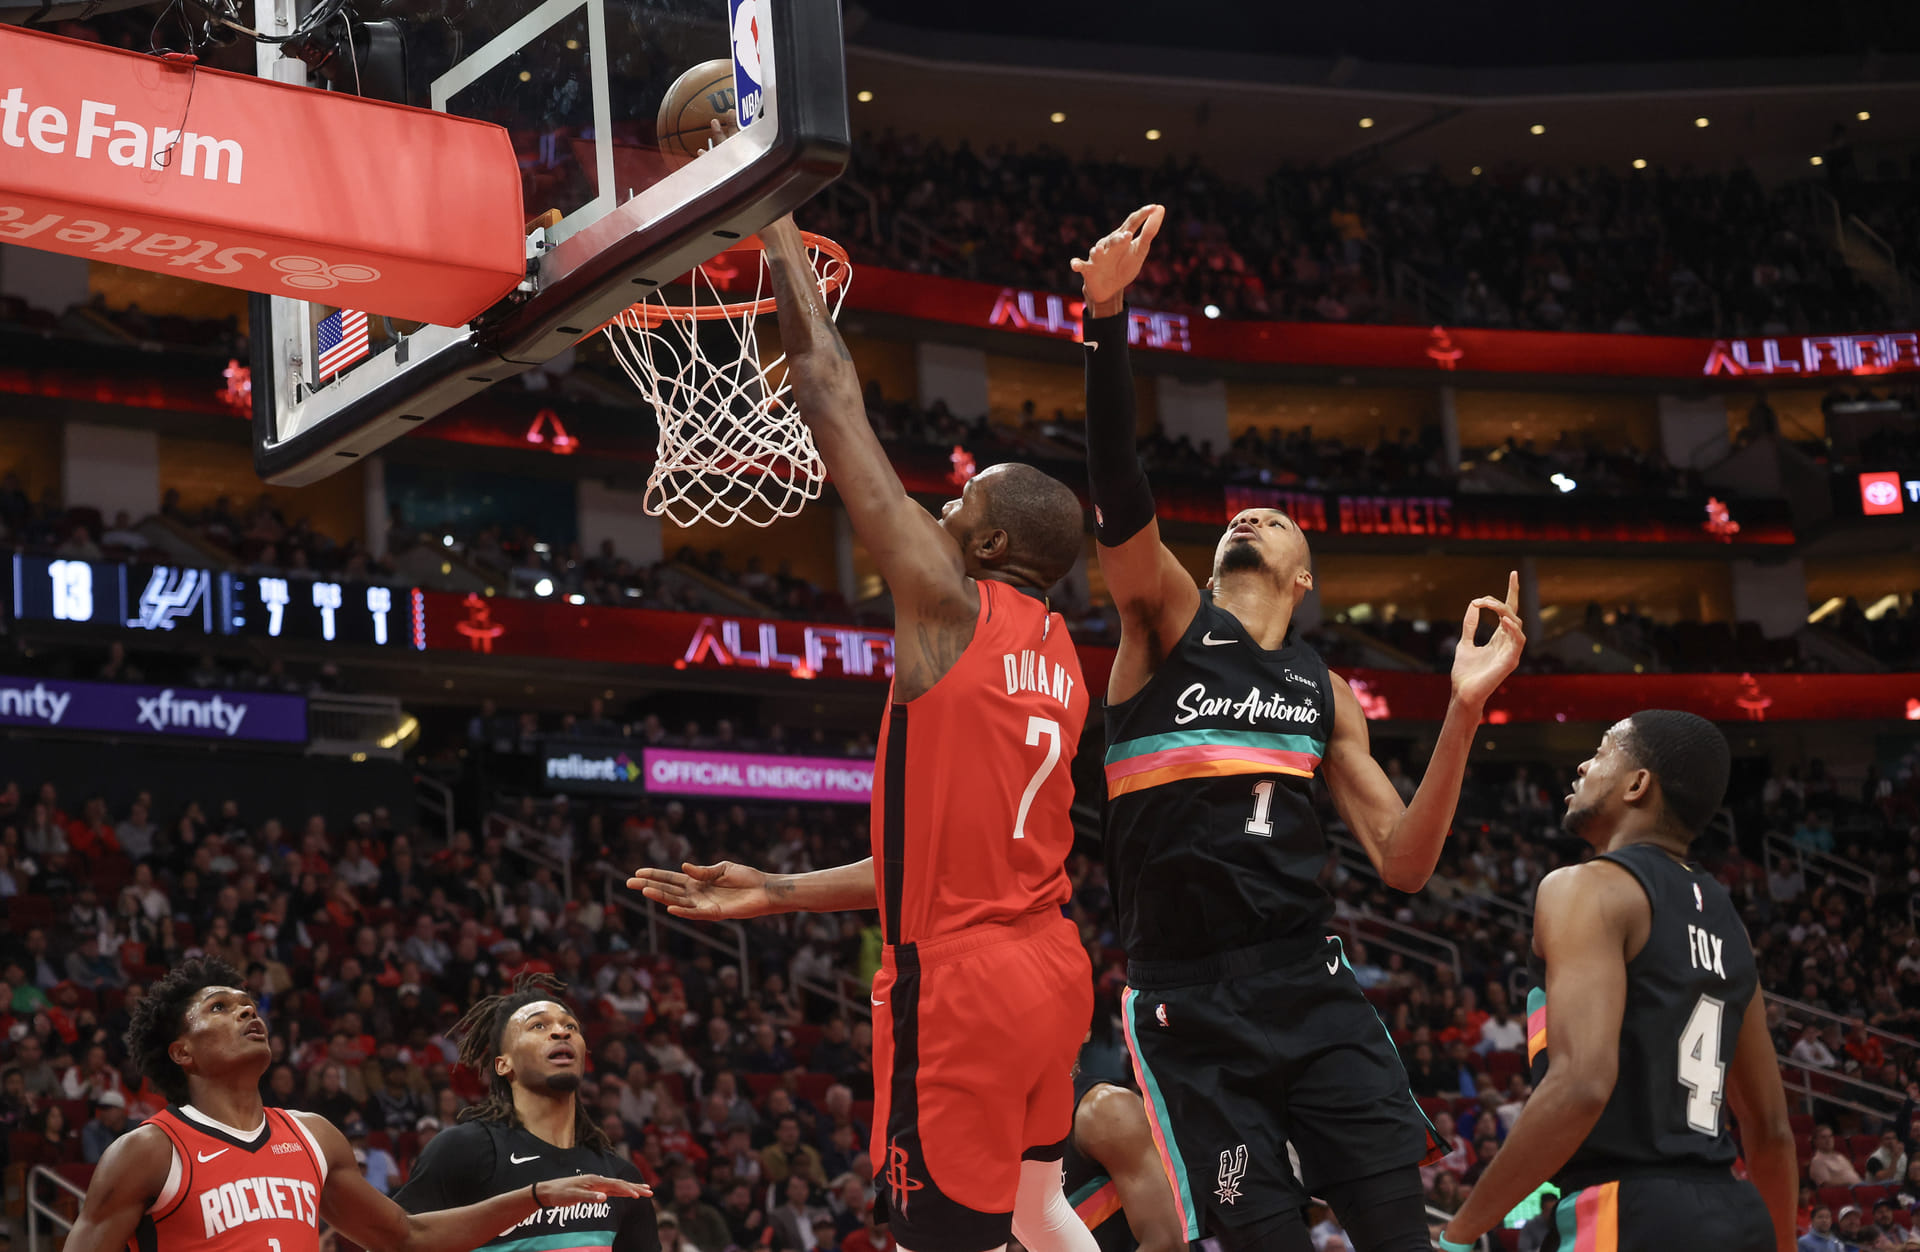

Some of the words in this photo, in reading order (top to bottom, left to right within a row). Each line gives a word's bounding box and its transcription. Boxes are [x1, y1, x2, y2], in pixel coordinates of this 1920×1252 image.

[741, 89, 760, 121] NBA
[1704, 338, 1800, 376] ALL
[48, 559, 94, 622] 13
[685, 617, 802, 668] ALL
[804, 627, 896, 677] FIR
[1003, 649, 1074, 710] DURANT
[1174, 682, 1233, 725] San
[1232, 686, 1321, 725] Antonio
[136, 689, 248, 736] xfinity
[547, 753, 617, 782] reliant
[652, 759, 744, 788] OFFICIAL
[746, 764, 823, 790] ENERGY
[1012, 716, 1062, 840] 7
[1244, 779, 1277, 838] 1
[1688, 924, 1727, 981] FOX
[1677, 993, 1726, 1138] 4
[199, 1176, 317, 1240] ROCKETS
